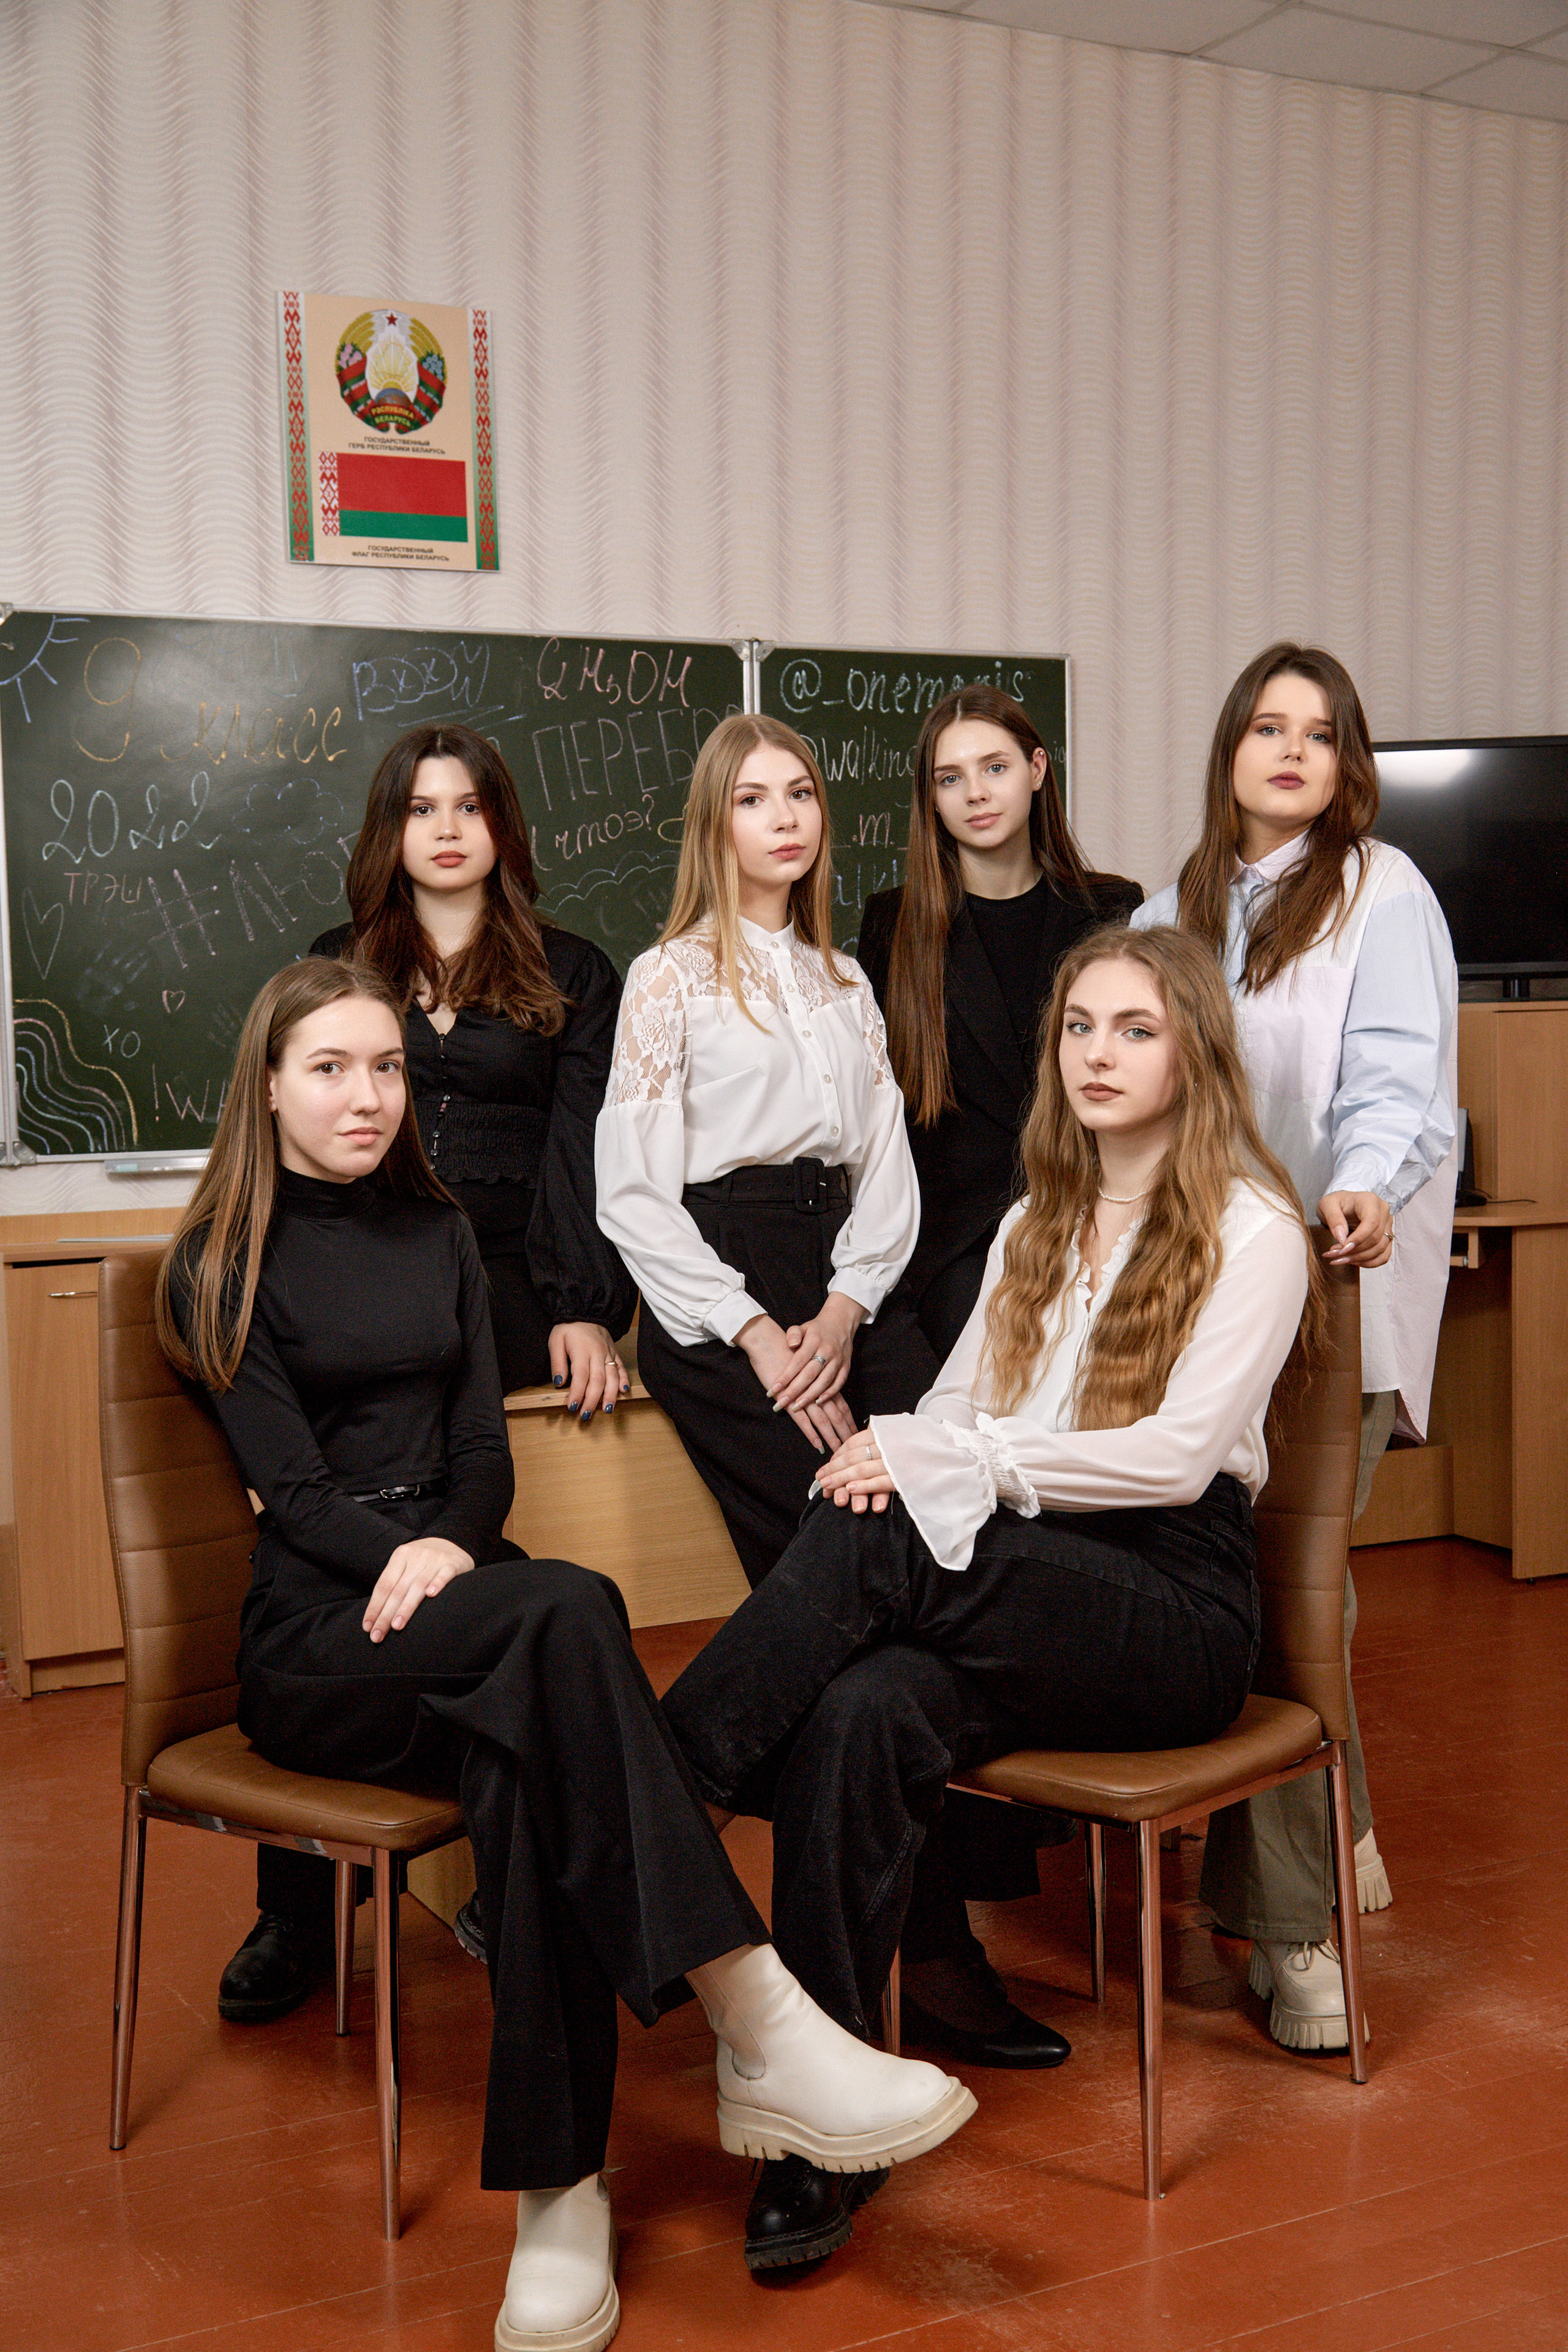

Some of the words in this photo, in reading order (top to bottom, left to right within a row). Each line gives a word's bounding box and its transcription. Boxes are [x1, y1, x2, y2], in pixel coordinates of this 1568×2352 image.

[364, 436, 430, 446] ГОСУДАРСТВЕННЫЙ
[366, 443, 410, 452] РЕСПУБЛИКИ
[411, 446, 446, 455] БЕЛАРУСЬ
[368, 545, 434, 553] ГОСУДАРСТВЕННЫЙ
[371, 551, 415, 560] РЕСПУБЛИКИ
[42, 771, 222, 864] 2022
